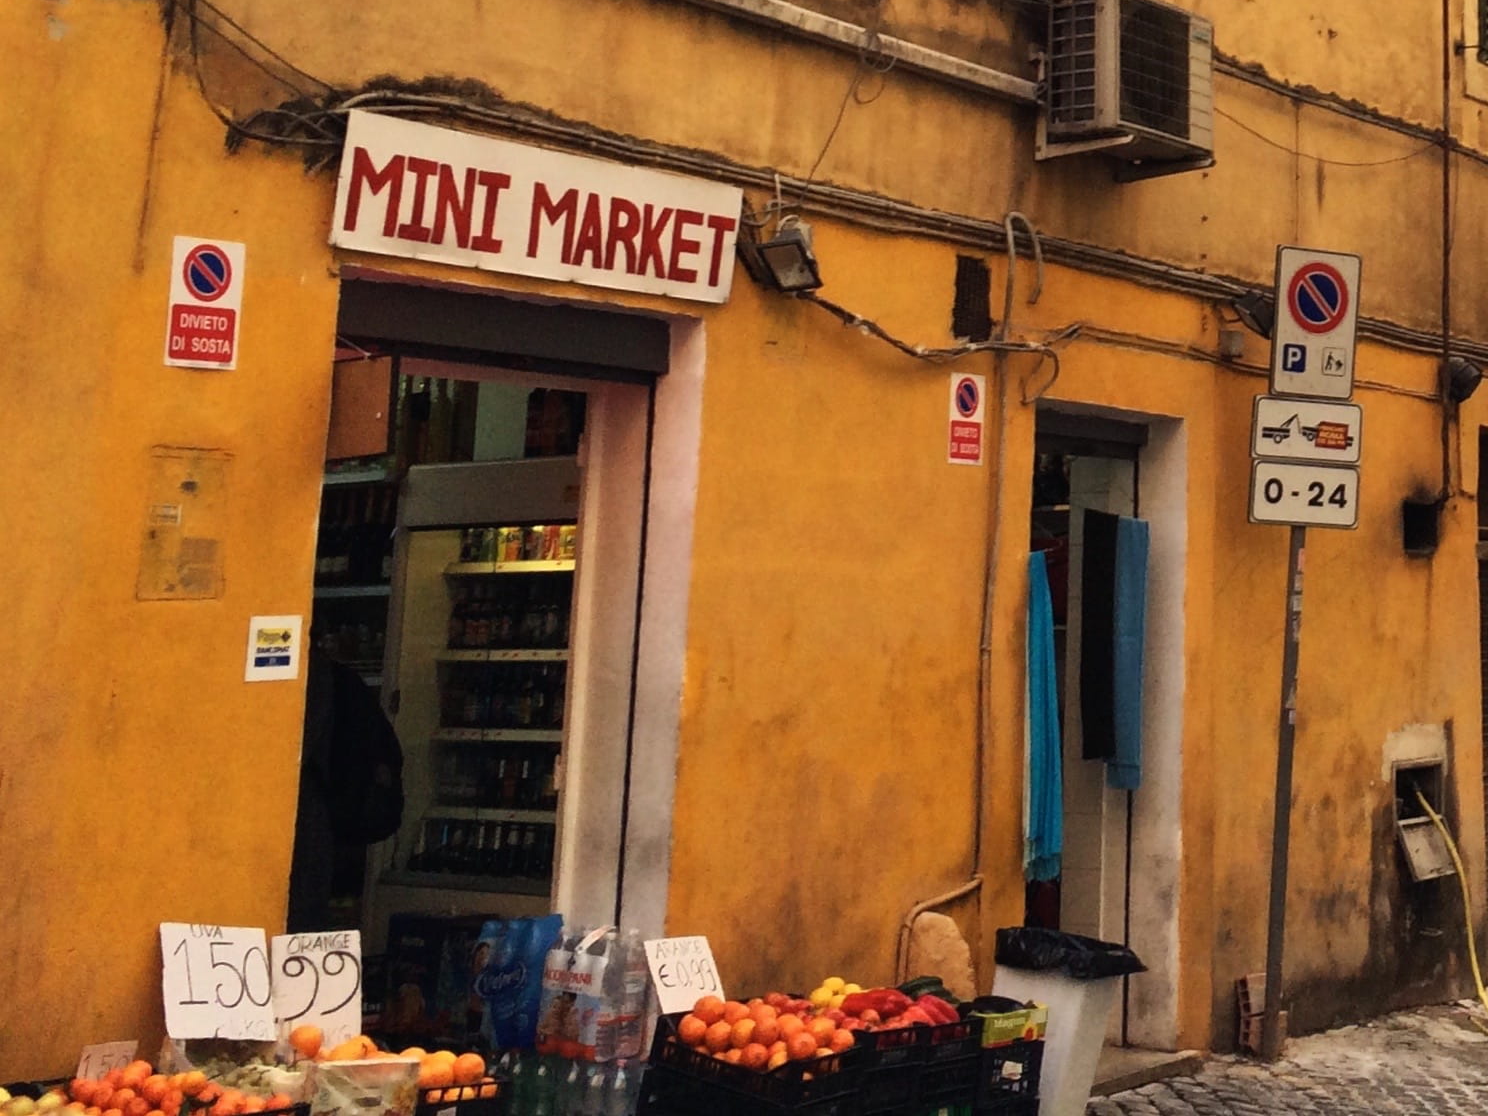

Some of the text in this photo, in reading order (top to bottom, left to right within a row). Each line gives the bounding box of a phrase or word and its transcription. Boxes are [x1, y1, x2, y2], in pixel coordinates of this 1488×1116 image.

[343, 146, 736, 287] MINI MARKET
[179, 313, 228, 331] DIVIETO
[171, 335, 231, 355] DI SOSTA
[1287, 347, 1302, 370] P
[287, 933, 350, 955] ORANGE
